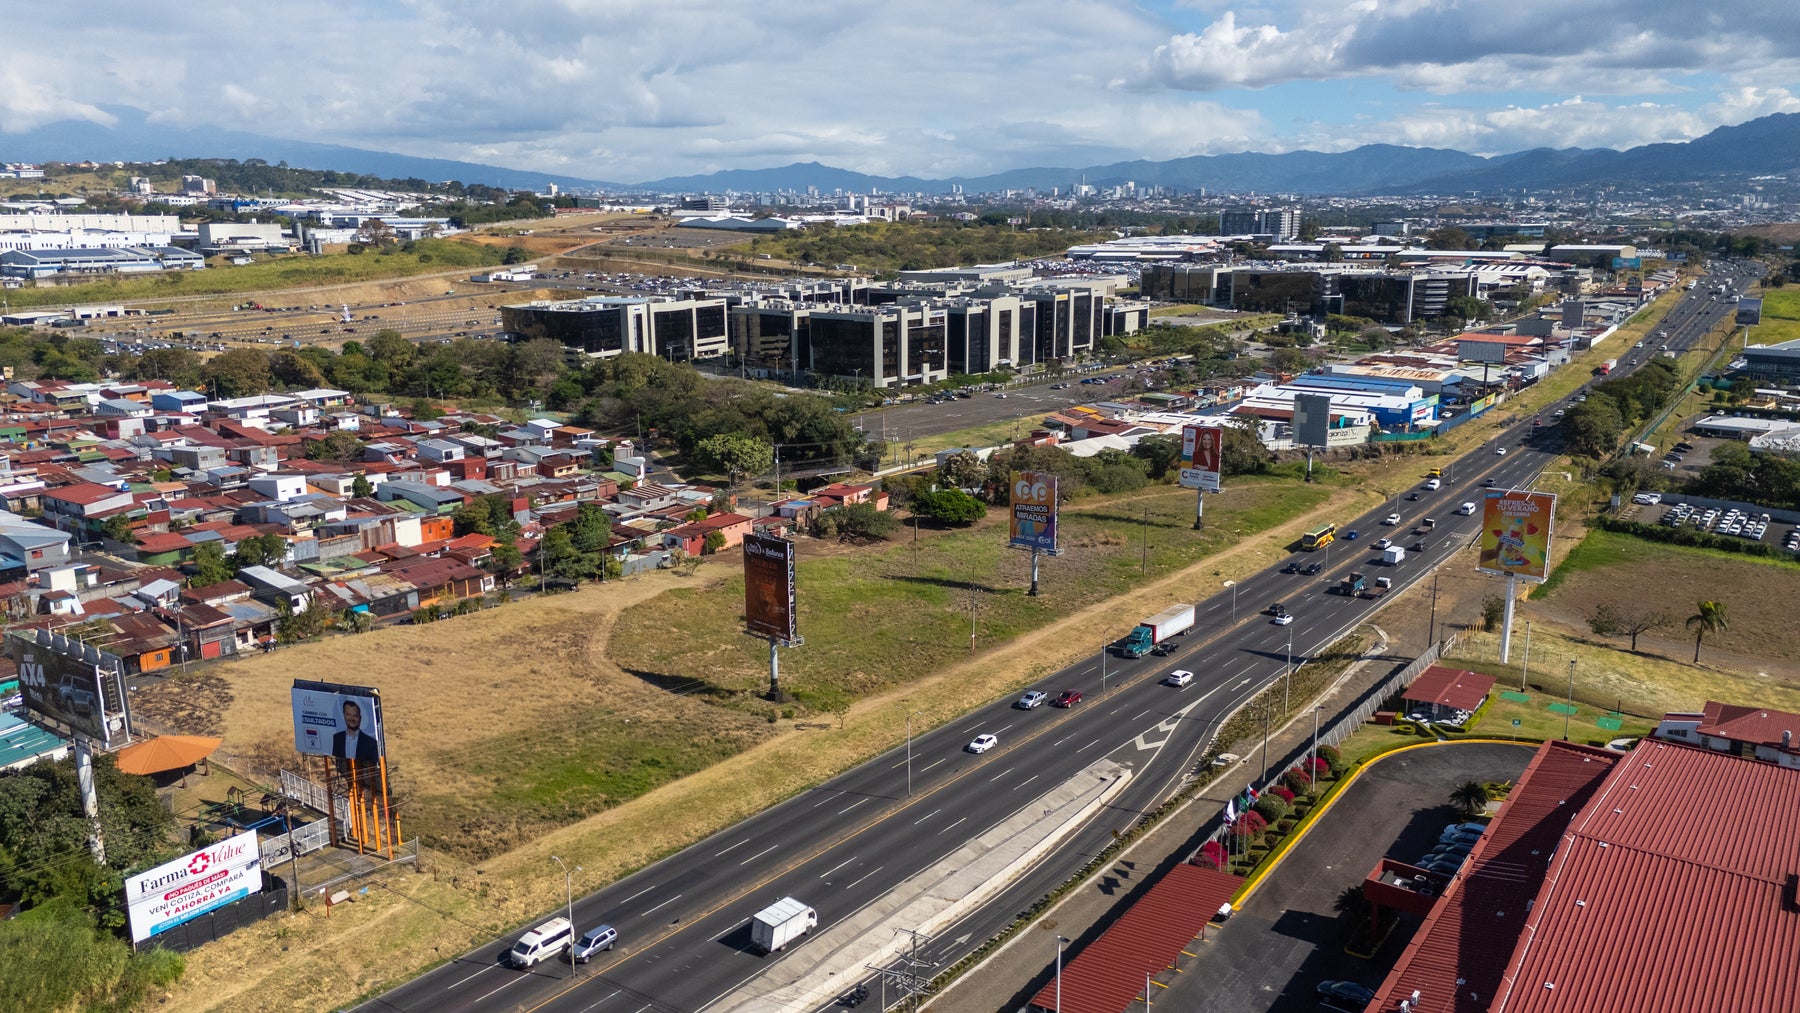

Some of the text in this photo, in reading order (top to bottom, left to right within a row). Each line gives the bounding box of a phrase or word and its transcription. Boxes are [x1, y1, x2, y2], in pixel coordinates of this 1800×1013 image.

[1016, 504, 1048, 513] ATRAEMOS
[1507, 505, 1539, 513] VERANO
[1016, 512, 1047, 523] MIRADAS
[21, 663, 45, 688] 4X4
[140, 843, 246, 893] Farma Value
[180, 881, 203, 894] PAGUES
[203, 877, 211, 885] DE
[174, 891, 215, 914] AHORRÁ
